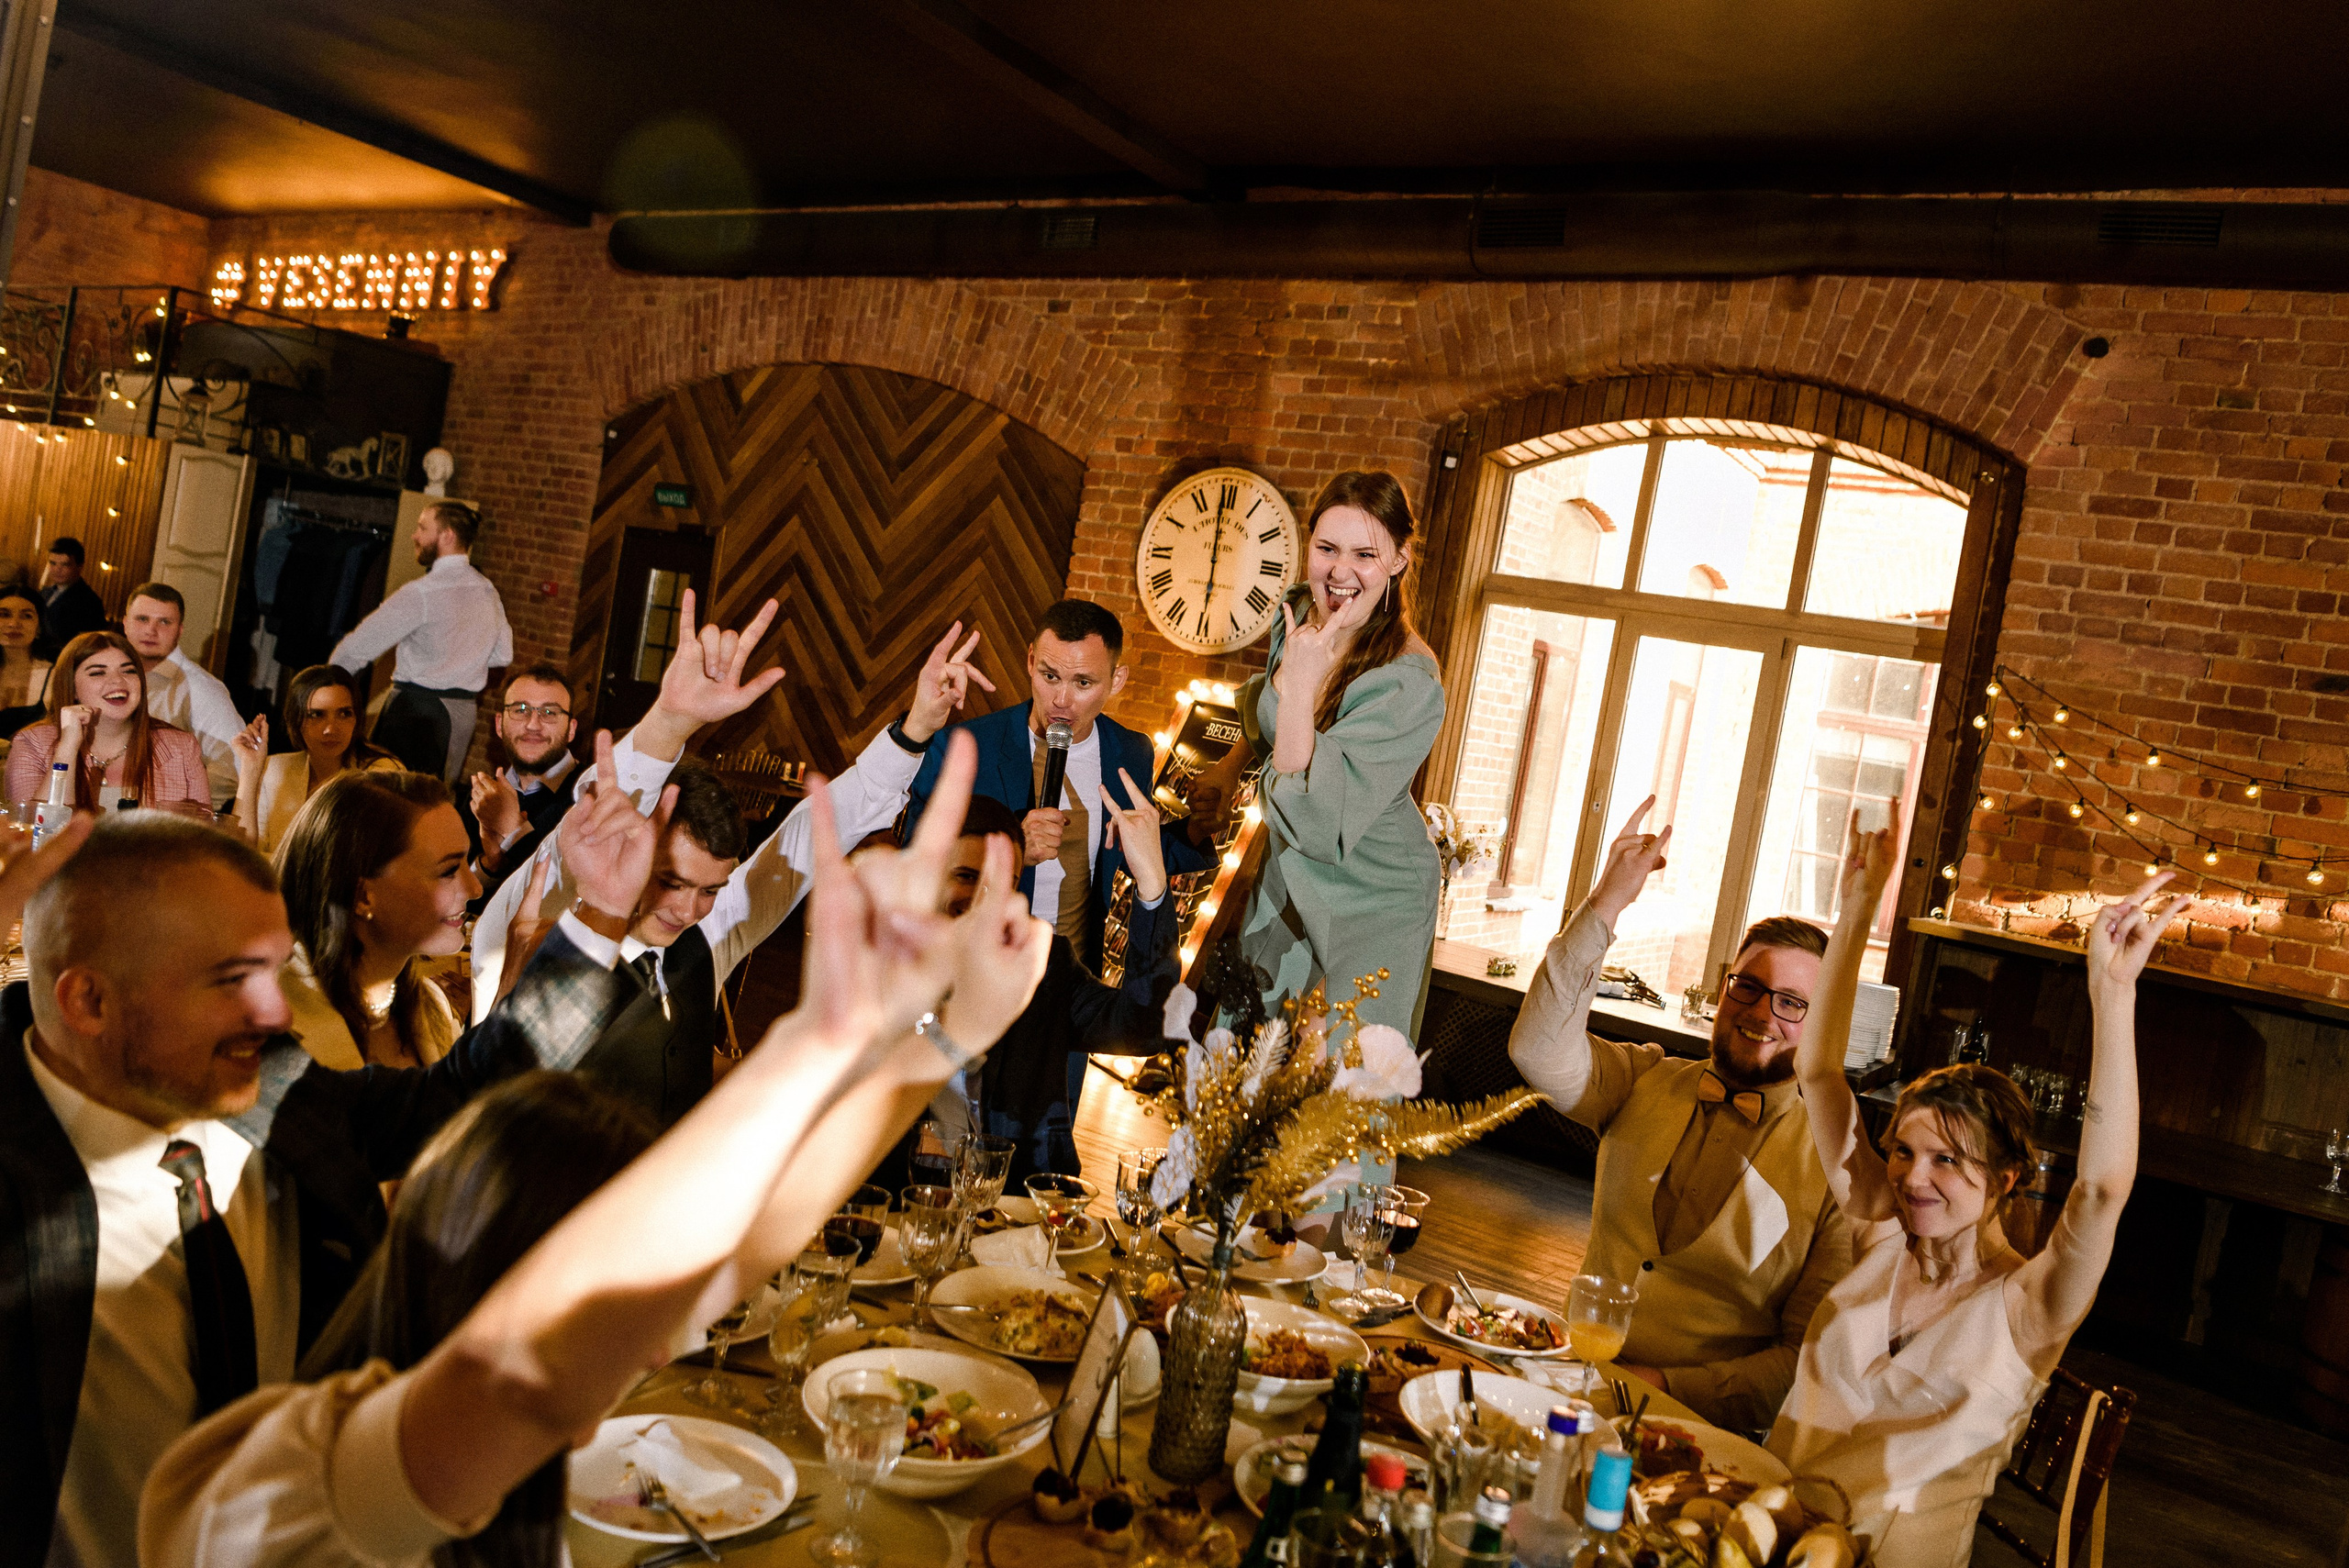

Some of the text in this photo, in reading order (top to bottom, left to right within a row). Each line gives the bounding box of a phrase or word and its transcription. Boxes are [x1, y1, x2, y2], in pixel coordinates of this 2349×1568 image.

[1191, 488, 1208, 516] XI
[1166, 511, 1186, 533] X
[1193, 516, 1232, 533] L'HOEL
[1204, 541, 1233, 553] FLURS
[1258, 527, 1281, 544] II
[1151, 544, 1174, 560] IX
[1260, 560, 1283, 577] III
[1151, 569, 1174, 599] VIII
[1166, 596, 1188, 627] VII
[1244, 585, 1272, 615] IIII
[1196, 611, 1210, 638] VI
[1230, 609, 1241, 634] V
